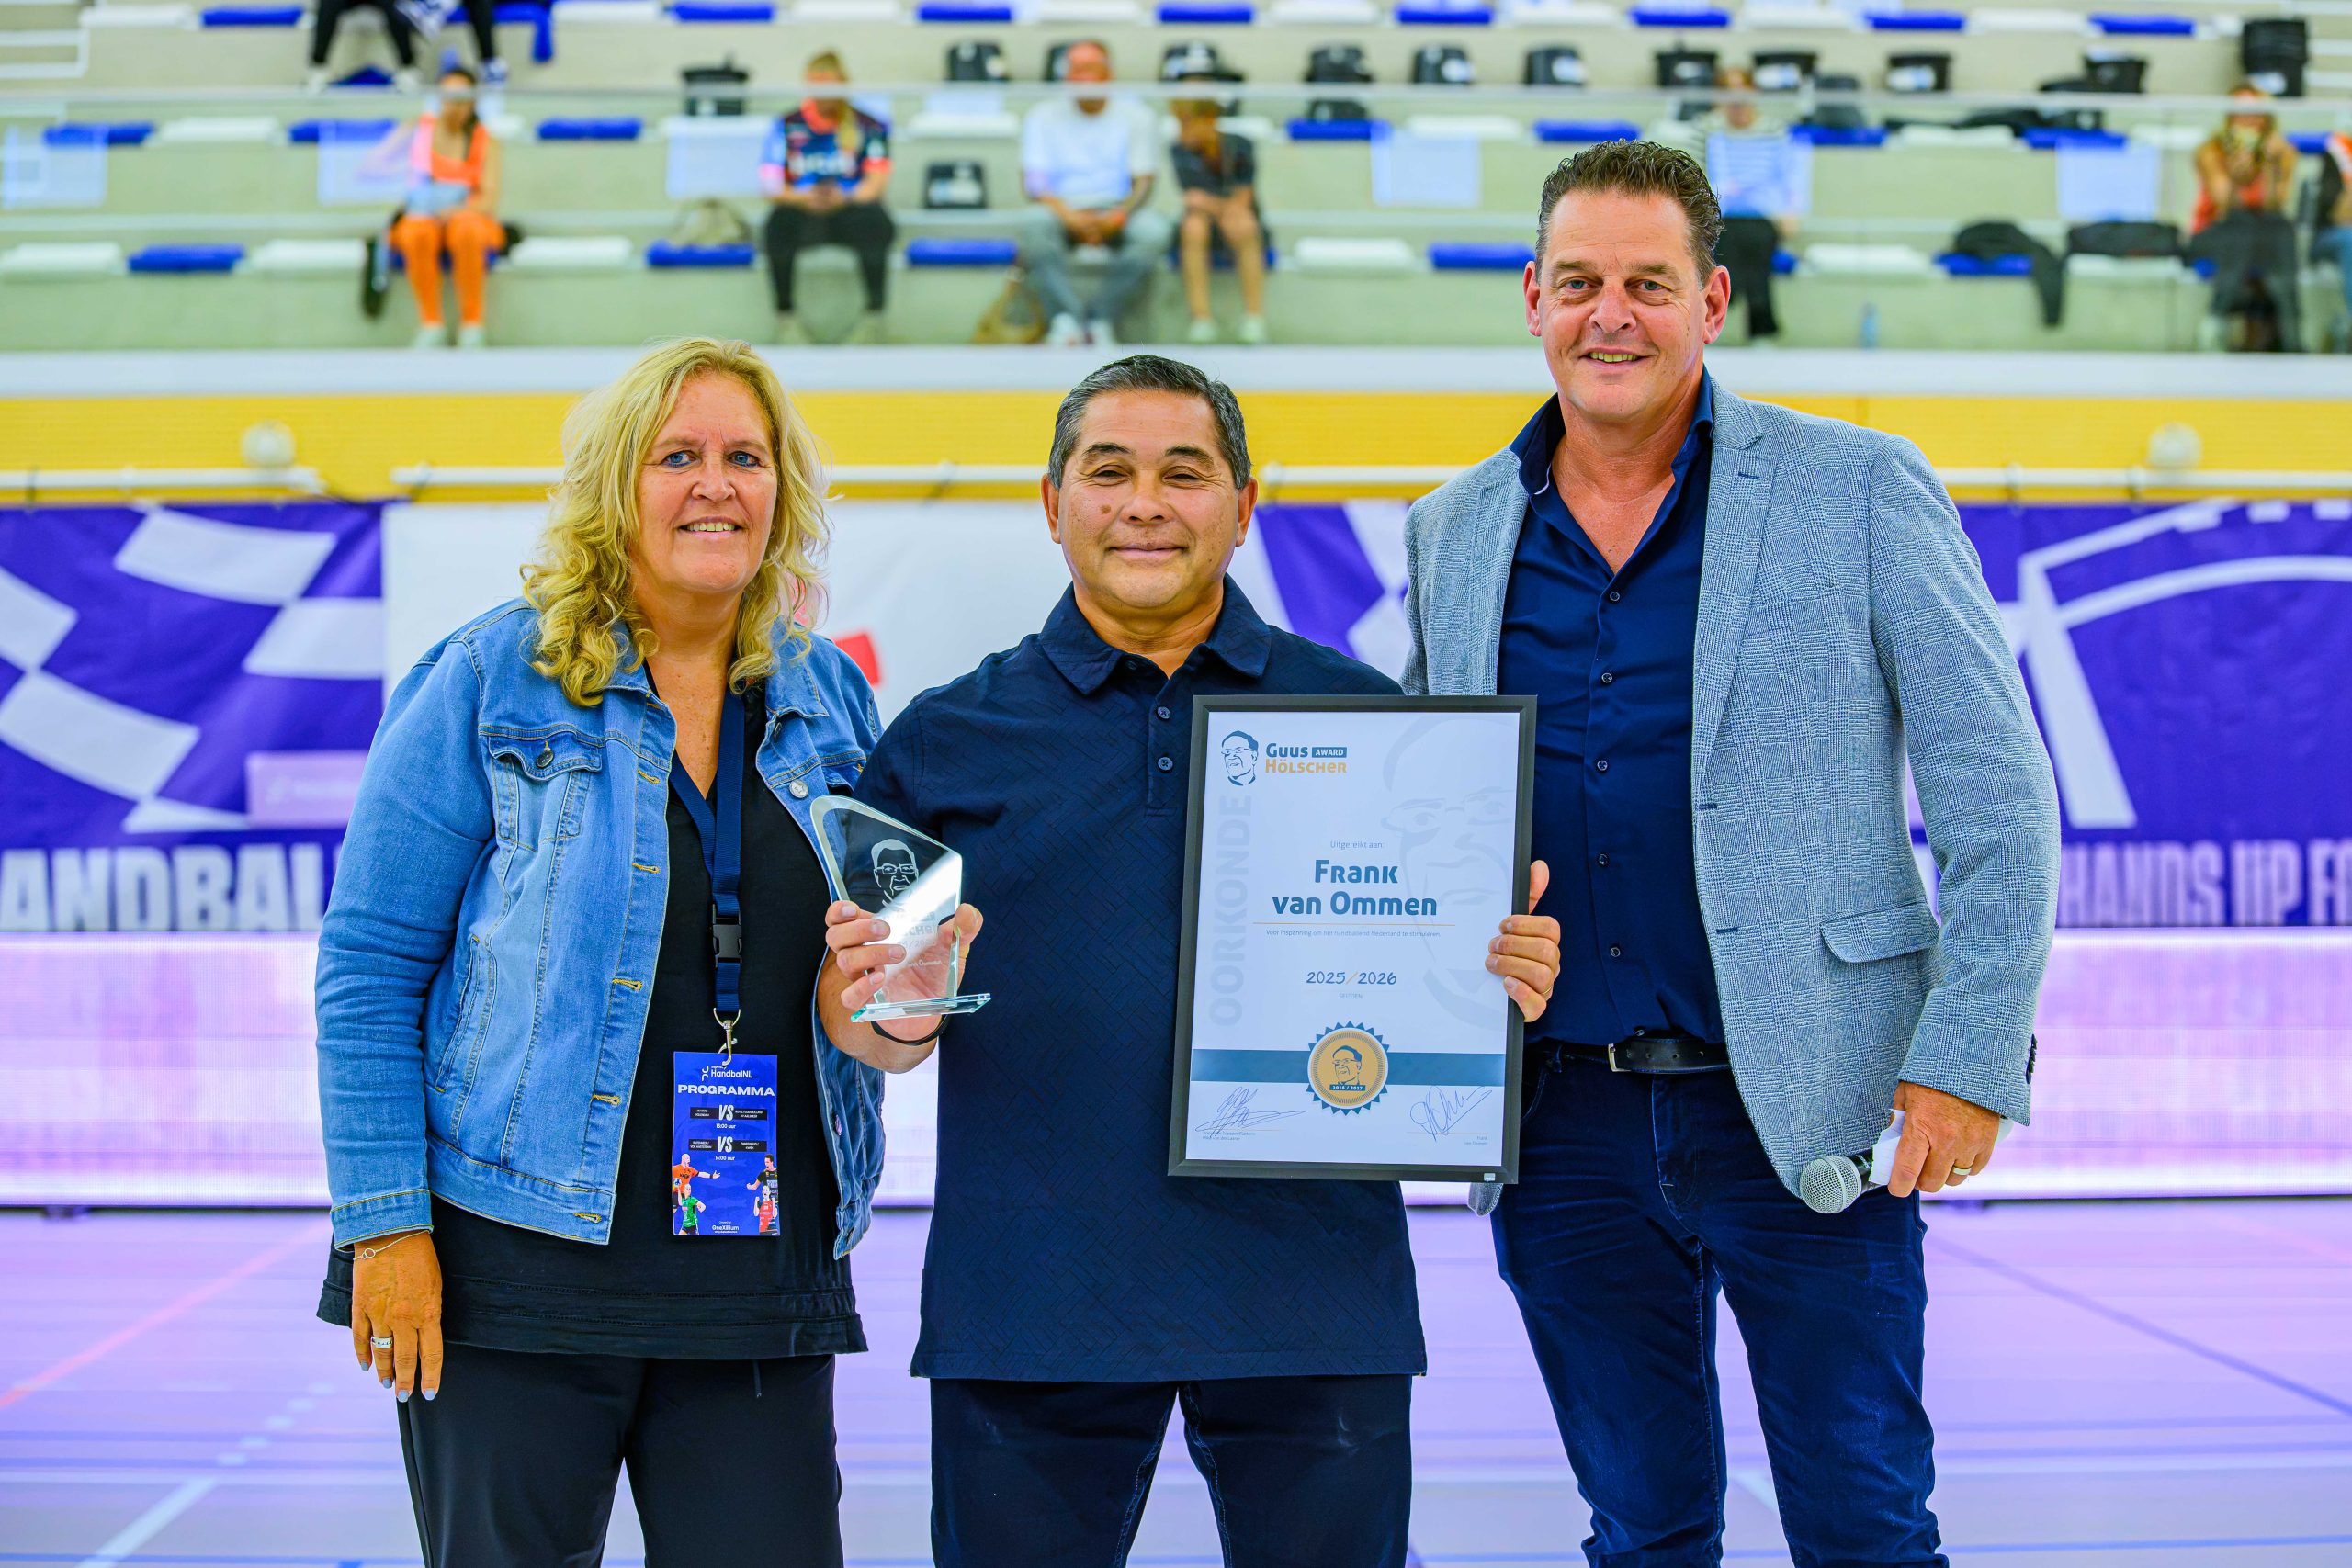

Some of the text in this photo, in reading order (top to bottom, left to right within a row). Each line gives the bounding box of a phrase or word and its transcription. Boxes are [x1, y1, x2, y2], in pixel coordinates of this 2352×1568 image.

[1266, 742, 1344, 758] Guus AWARD
[1330, 840, 1367, 850] Uitgereikt
[1315, 859, 1398, 884] Frank
[0, 844, 342, 932] ANDBAL
[2057, 841, 2225, 928] HANDS
[2230, 840, 2302, 927] UP
[1208, 795, 1252, 1027] OORKONDE
[1272, 890, 1438, 916] van Ommen
[1280, 929, 1312, 938] inspanning
[678, 1084, 775, 1097] PROGRAMMA
[718, 1104, 734, 1121] VS
[718, 1135, 733, 1153] VS
